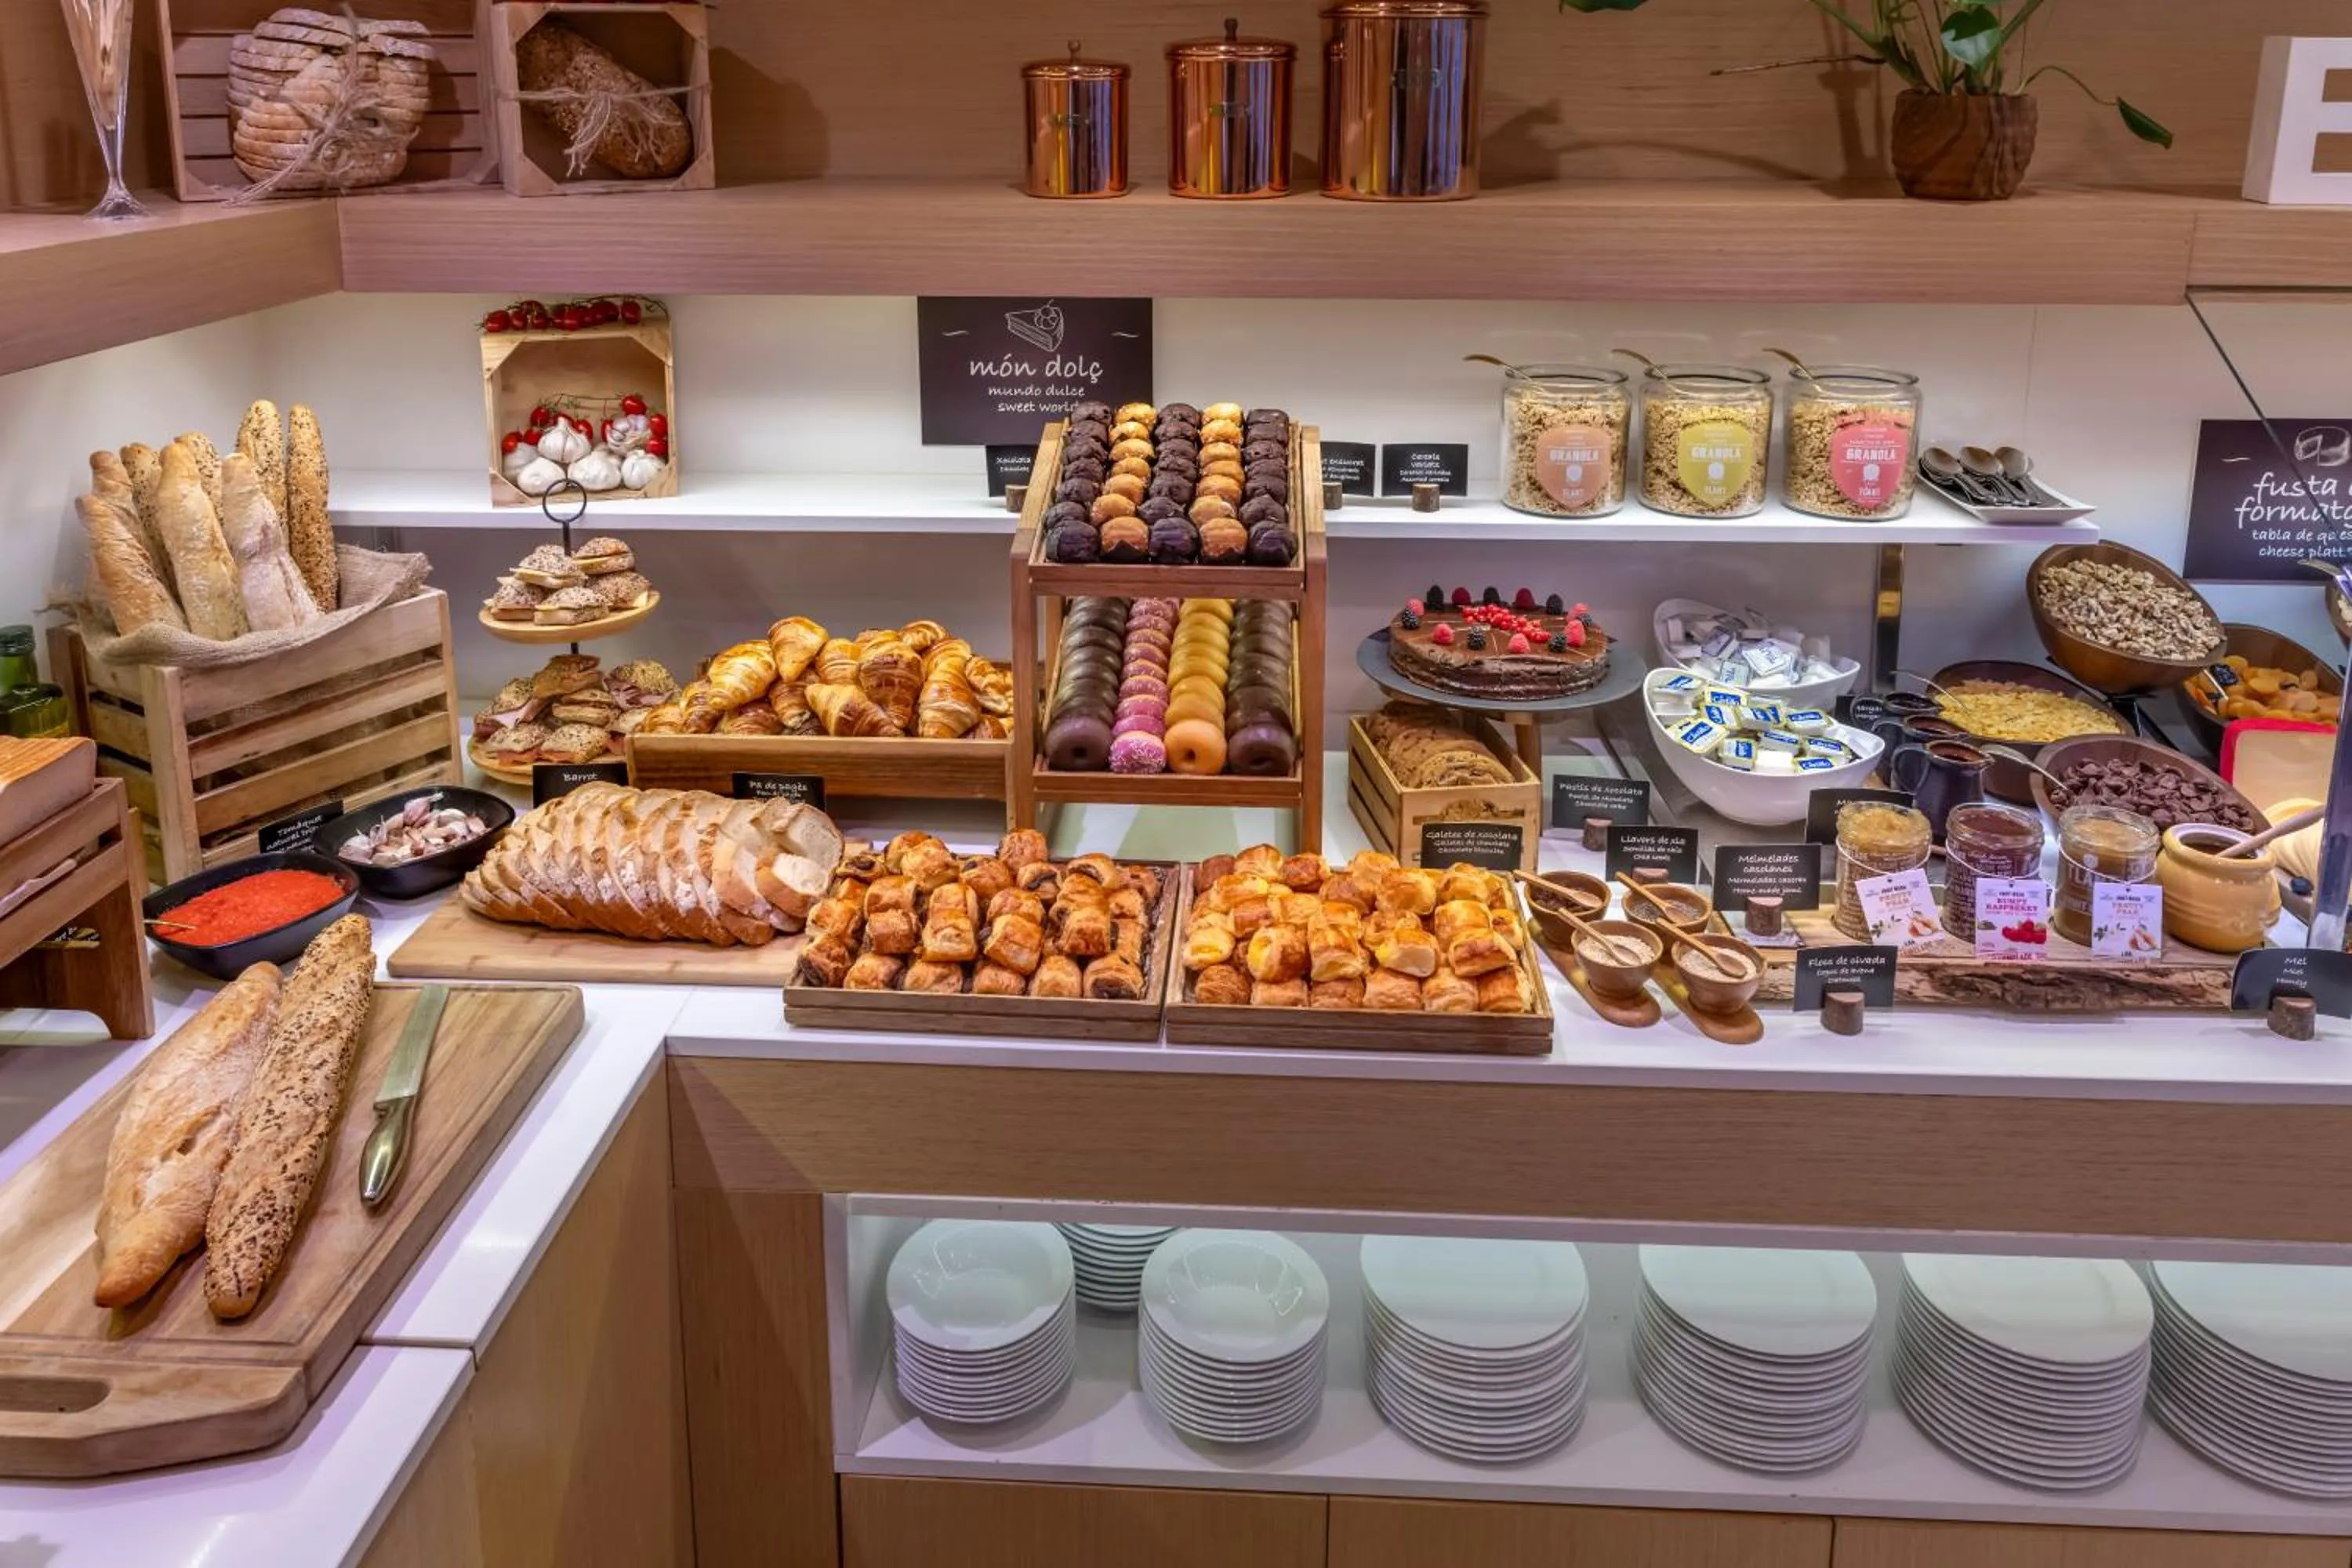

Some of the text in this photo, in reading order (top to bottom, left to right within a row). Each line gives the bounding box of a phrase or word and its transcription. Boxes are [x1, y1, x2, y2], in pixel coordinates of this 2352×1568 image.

[970, 353, 1103, 383] món dolç
[988, 383, 1085, 397] mundo dulce
[998, 401, 1036, 412] sweet
[1549, 449, 1599, 461] GRANOLA
[1690, 446, 1742, 459] GRANOLA
[1846, 448, 1896, 461] GRANOLA
[2253, 472, 2338, 504] fusta
[2252, 528, 2291, 540] tabla
[2296, 528, 2314, 542] de
[2259, 546, 2305, 557] cheese
[1464, 829, 1476, 839] de
[1621, 835, 1656, 844] Llavors
[1657, 835, 1669, 844] de
[1737, 853, 1800, 863] Melmelades
[1835, 956, 1849, 965] de
[2282, 956, 2308, 965] Mel
